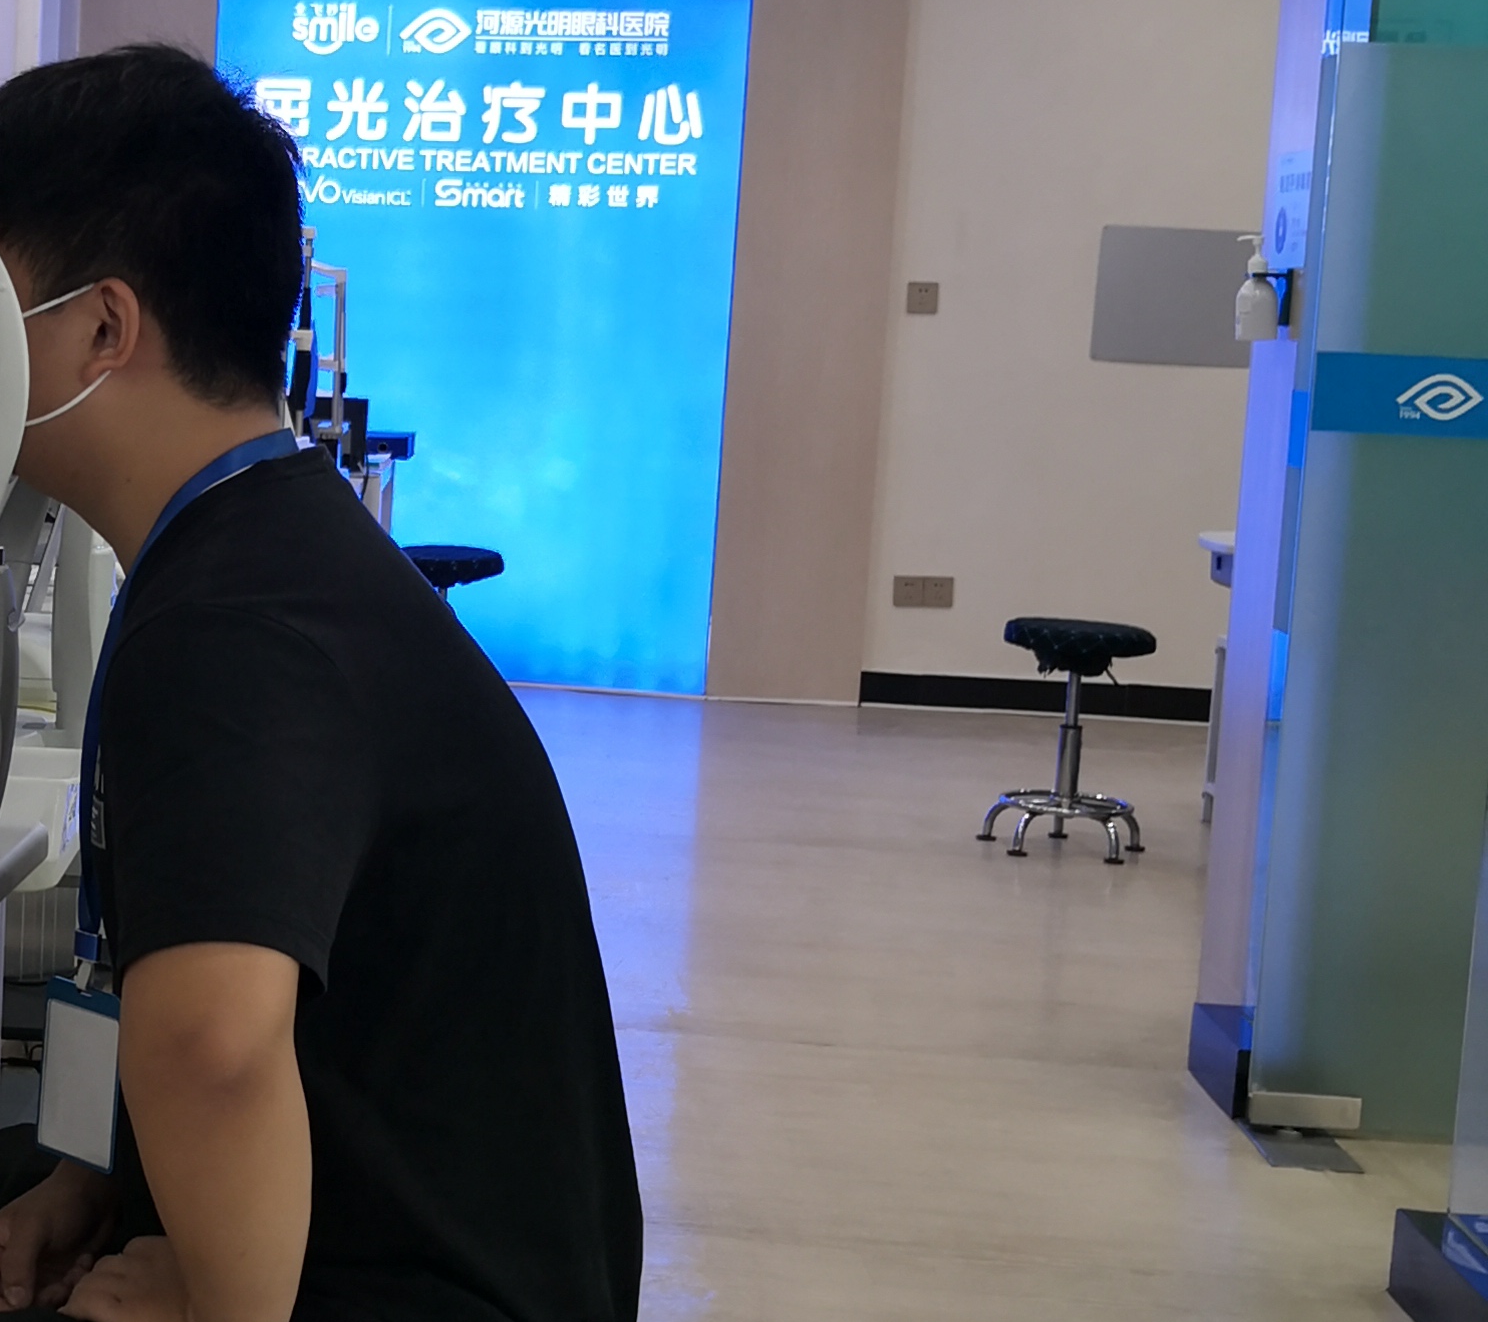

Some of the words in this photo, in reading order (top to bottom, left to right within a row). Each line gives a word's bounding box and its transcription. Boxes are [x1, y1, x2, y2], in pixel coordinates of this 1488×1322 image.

[291, 2, 380, 43] smile
[475, 8, 670, 37] 河源光明眼科医院
[255, 77, 705, 146] 屈光治疗中心
[299, 147, 416, 172] RACTIVE
[418, 149, 584, 175] TREATMENT
[586, 152, 698, 176] CENTER
[298, 175, 342, 205] VO
[434, 178, 527, 209] Smart
[548, 183, 660, 209] 精彩世界
